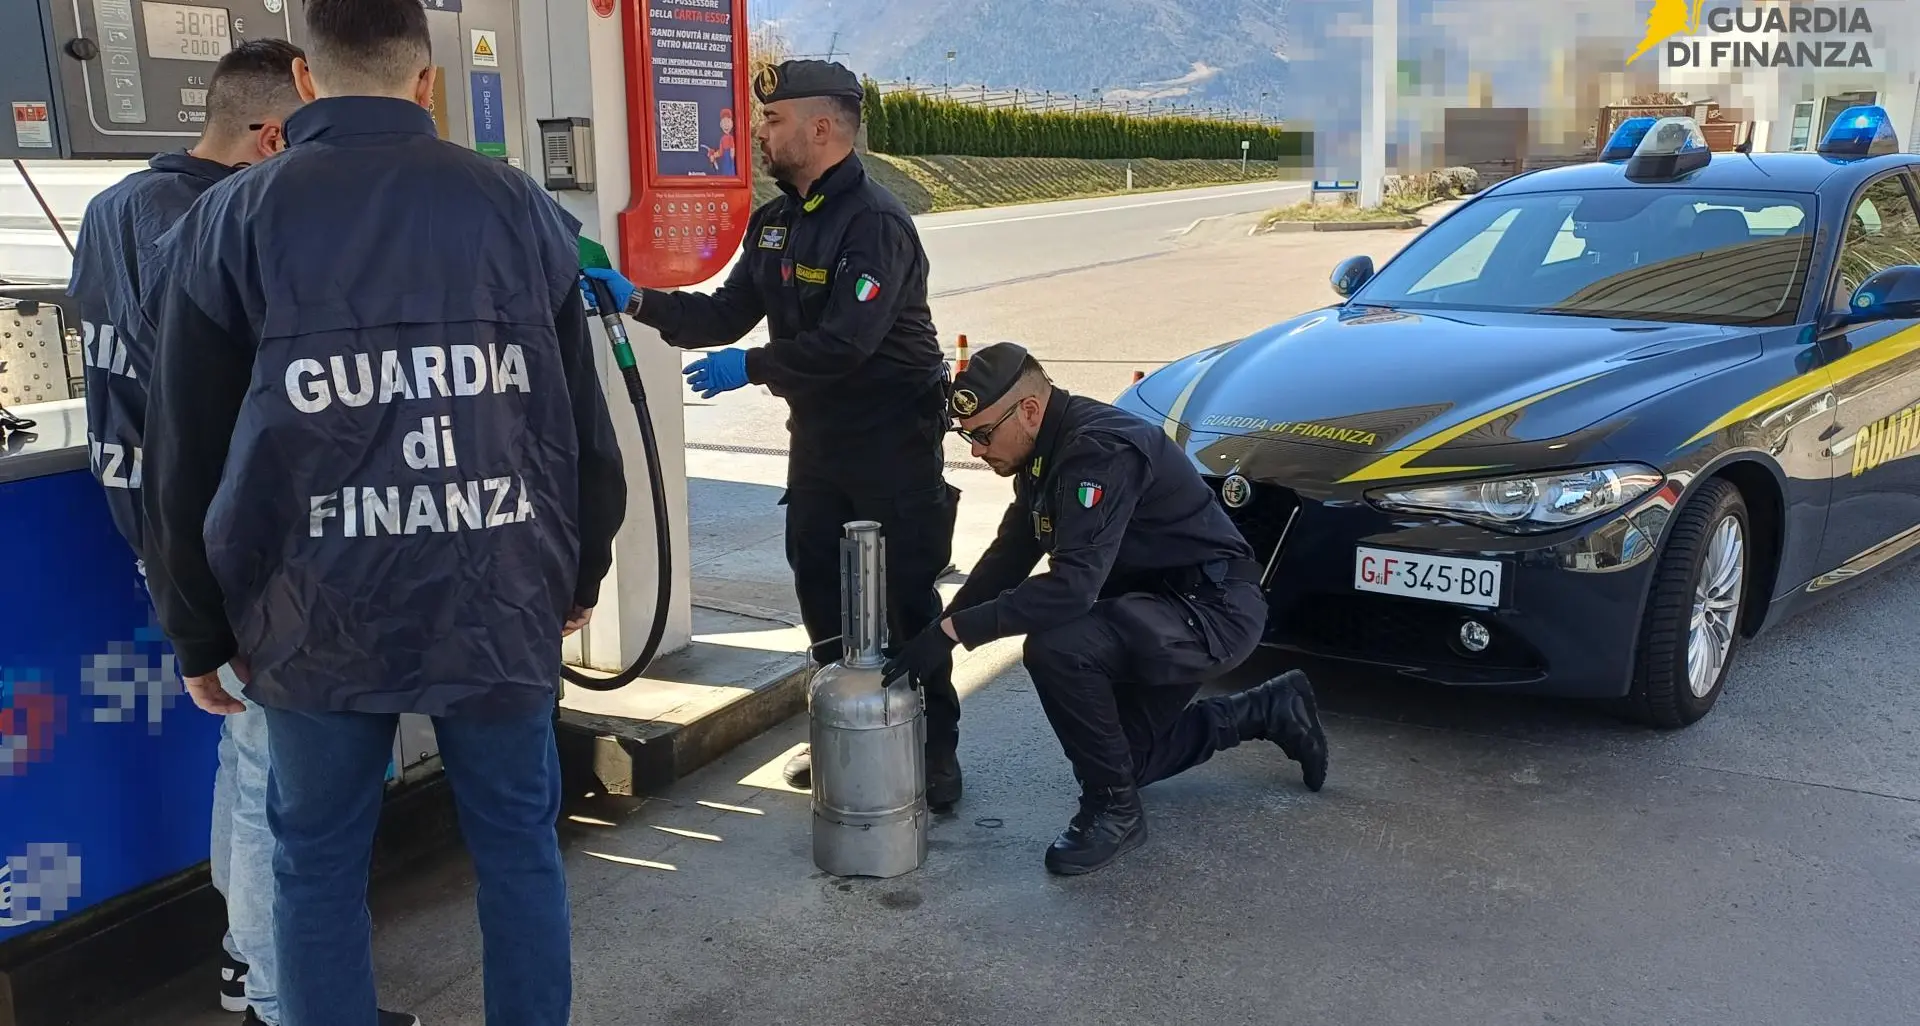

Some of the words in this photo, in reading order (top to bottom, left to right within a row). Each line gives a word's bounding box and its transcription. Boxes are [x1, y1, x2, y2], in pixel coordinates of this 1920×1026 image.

[649, 8, 673, 19] DELLA
[674, 9, 702, 21] CARTA
[479, 45, 488, 53] EX
[657, 39, 681, 49] ENTRO
[681, 41, 708, 51] NATALE
[482, 90, 493, 130] Benzina
[285, 343, 531, 414] GUARDIA
[402, 415, 457, 470] di
[1202, 414, 1269, 430] GUARDIA
[1269, 421, 1289, 433] di
[1289, 423, 1377, 446] FINANZA
[1080, 481, 1102, 489] ITALIA
[309, 475, 536, 538] FINANZA
